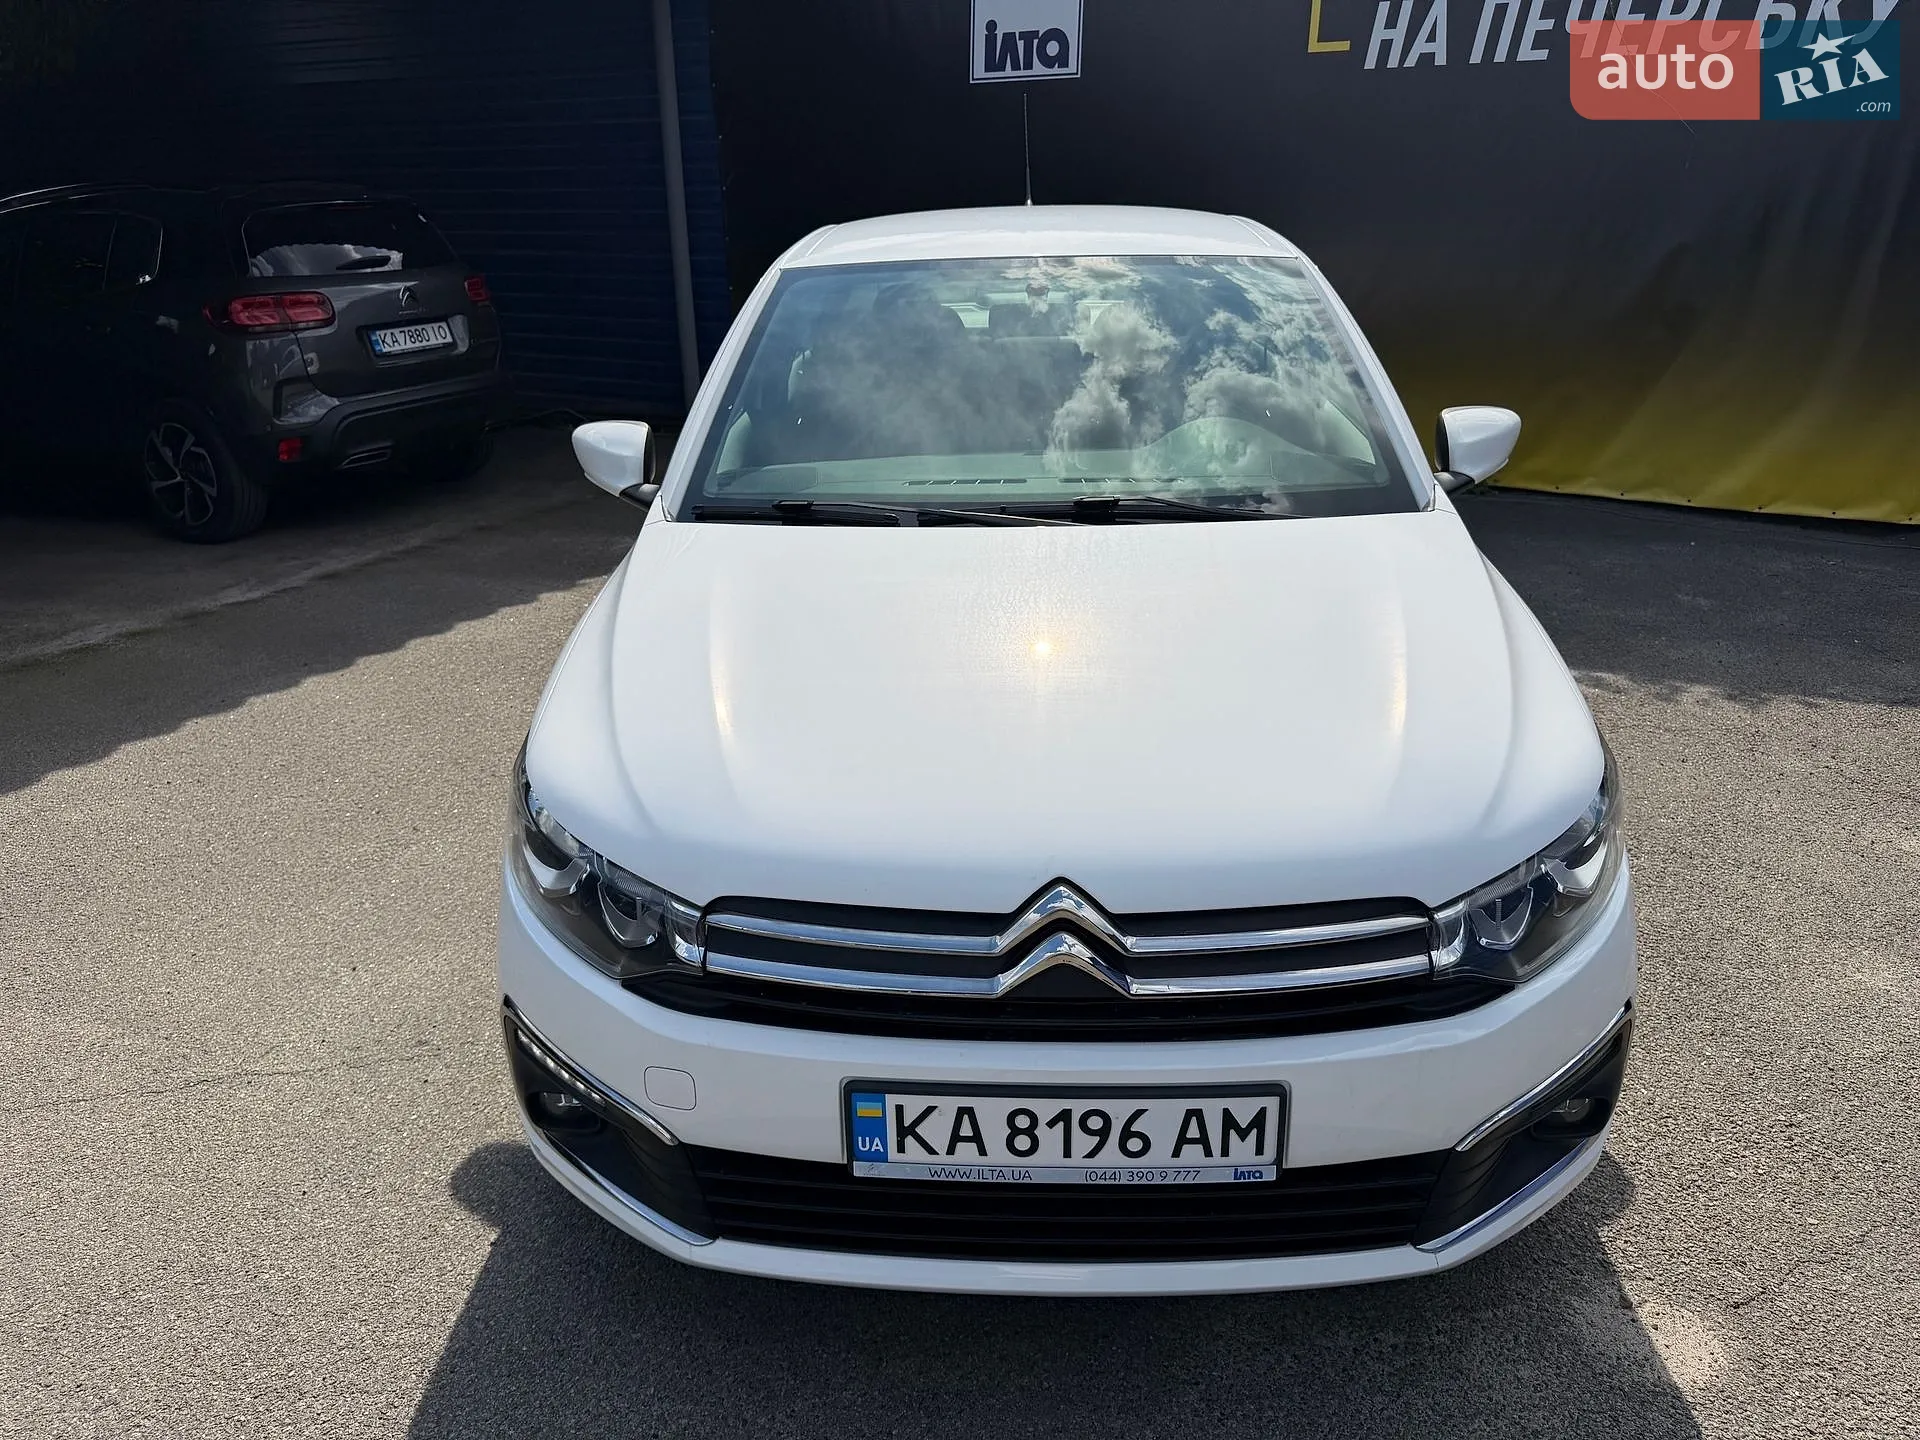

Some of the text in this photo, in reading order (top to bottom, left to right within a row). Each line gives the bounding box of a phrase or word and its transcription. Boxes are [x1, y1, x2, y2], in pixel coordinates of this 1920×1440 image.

[1363, 0, 1448, 69] НА
[379, 331, 401, 349] KA
[399, 327, 430, 346] 7880
[894, 1103, 1268, 1159] KA 8196 AM
[858, 1137, 884, 1153] UA
[928, 1167, 1200, 1182] WWW.ILTA.UA (044) 390 9 777
